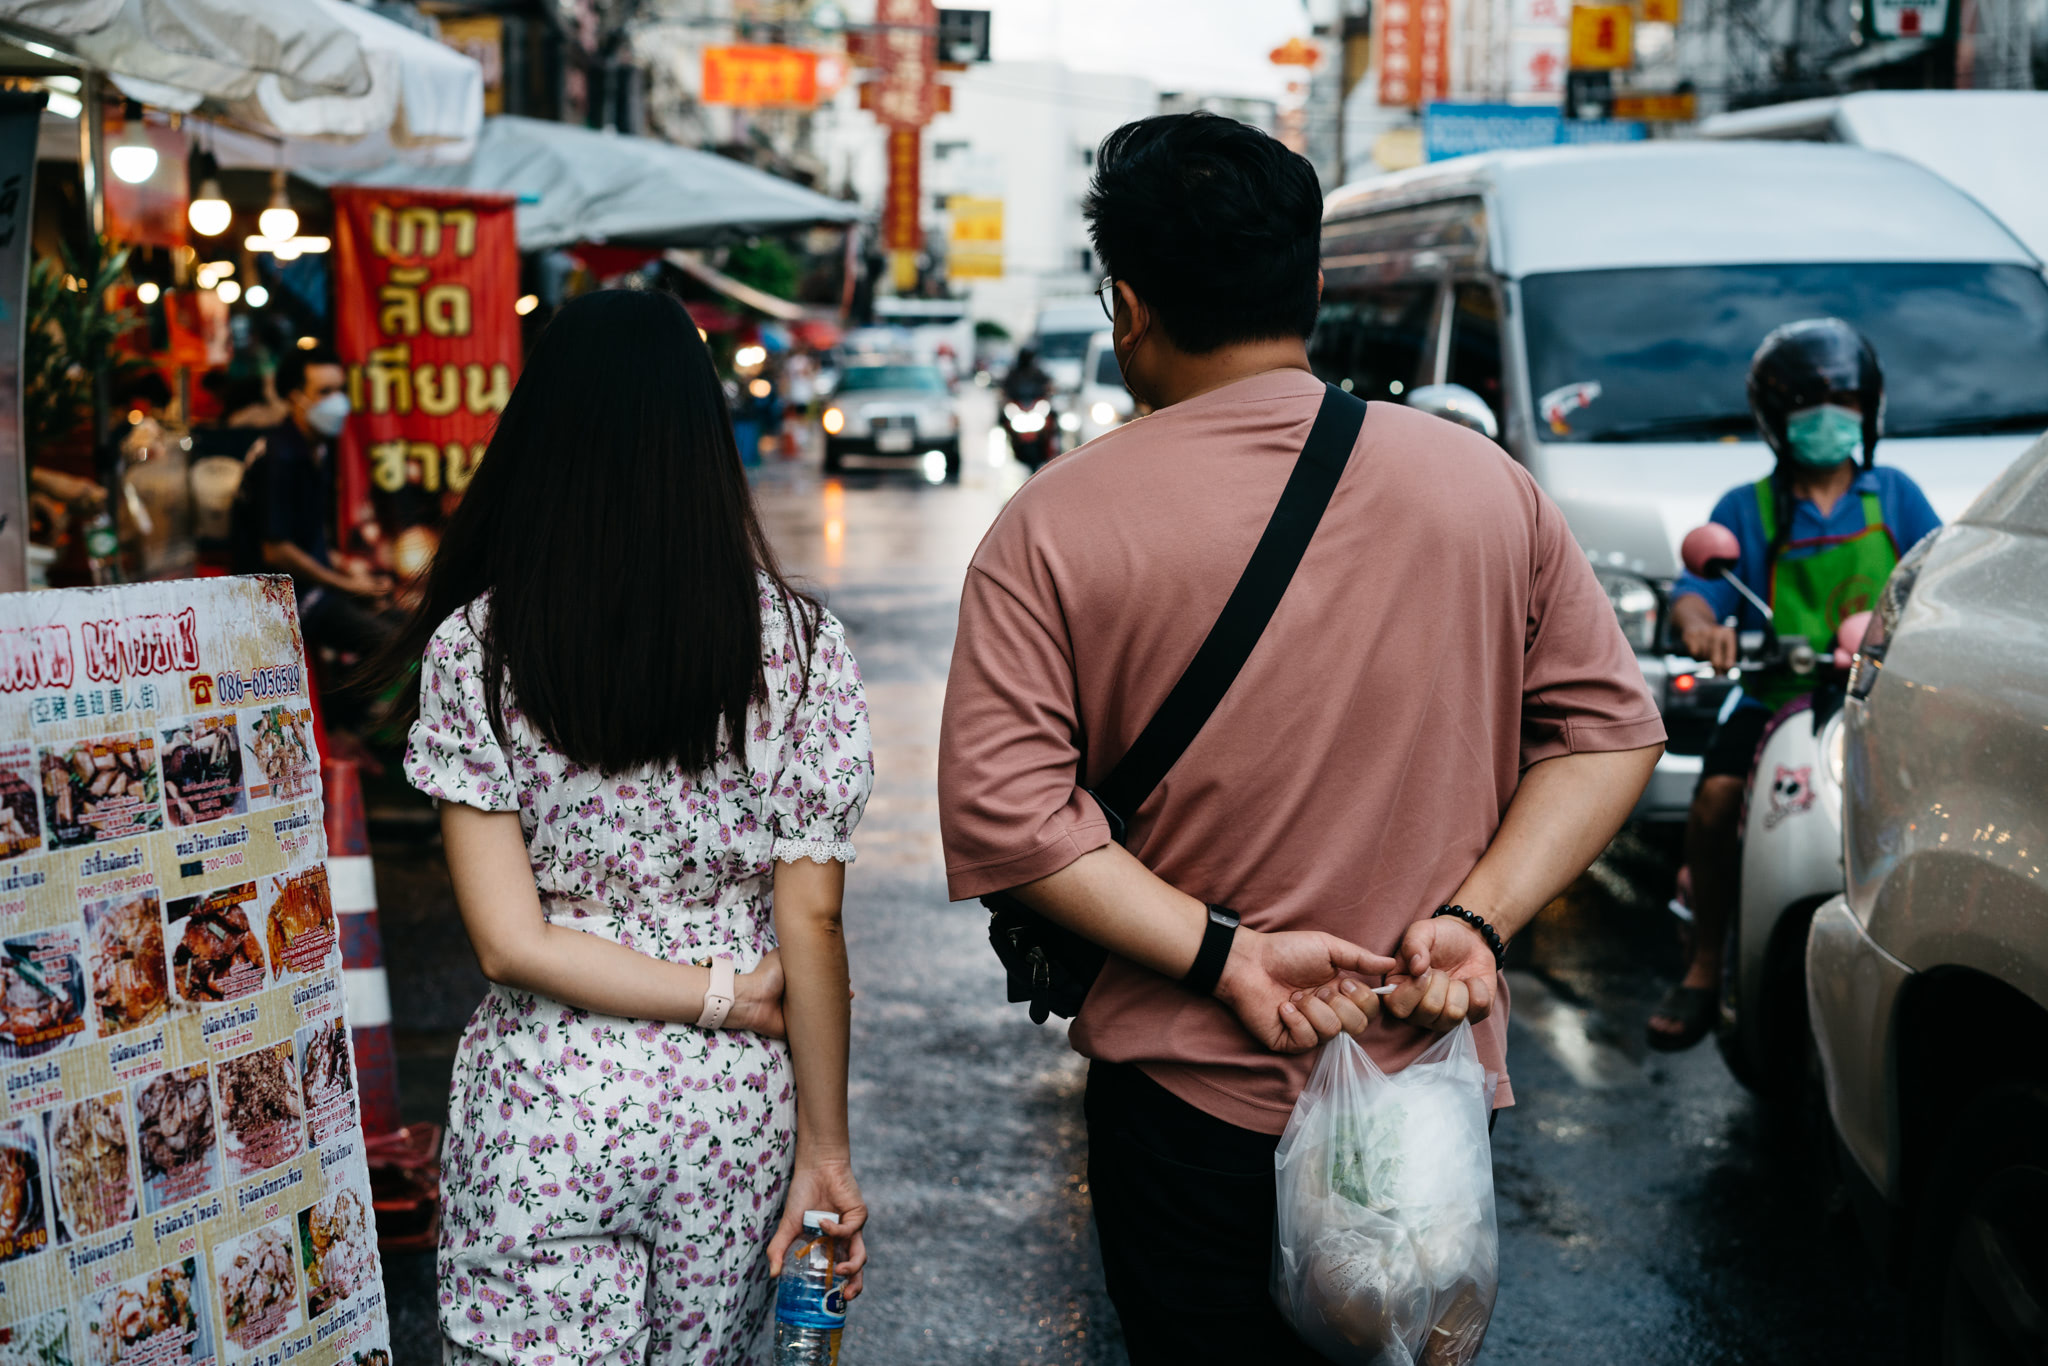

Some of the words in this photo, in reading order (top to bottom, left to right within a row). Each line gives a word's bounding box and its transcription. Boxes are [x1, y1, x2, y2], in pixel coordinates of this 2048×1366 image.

[372, 206, 477, 258] เกา
[380, 267, 471, 337] ลัด
[351, 343, 511, 416] เทียน
[216, 662, 302, 705] 086-6056529
[274, 1040, 293, 1061] 600
[265, 1203, 279, 1220] 600
[179, 1237, 195, 1254] 600
